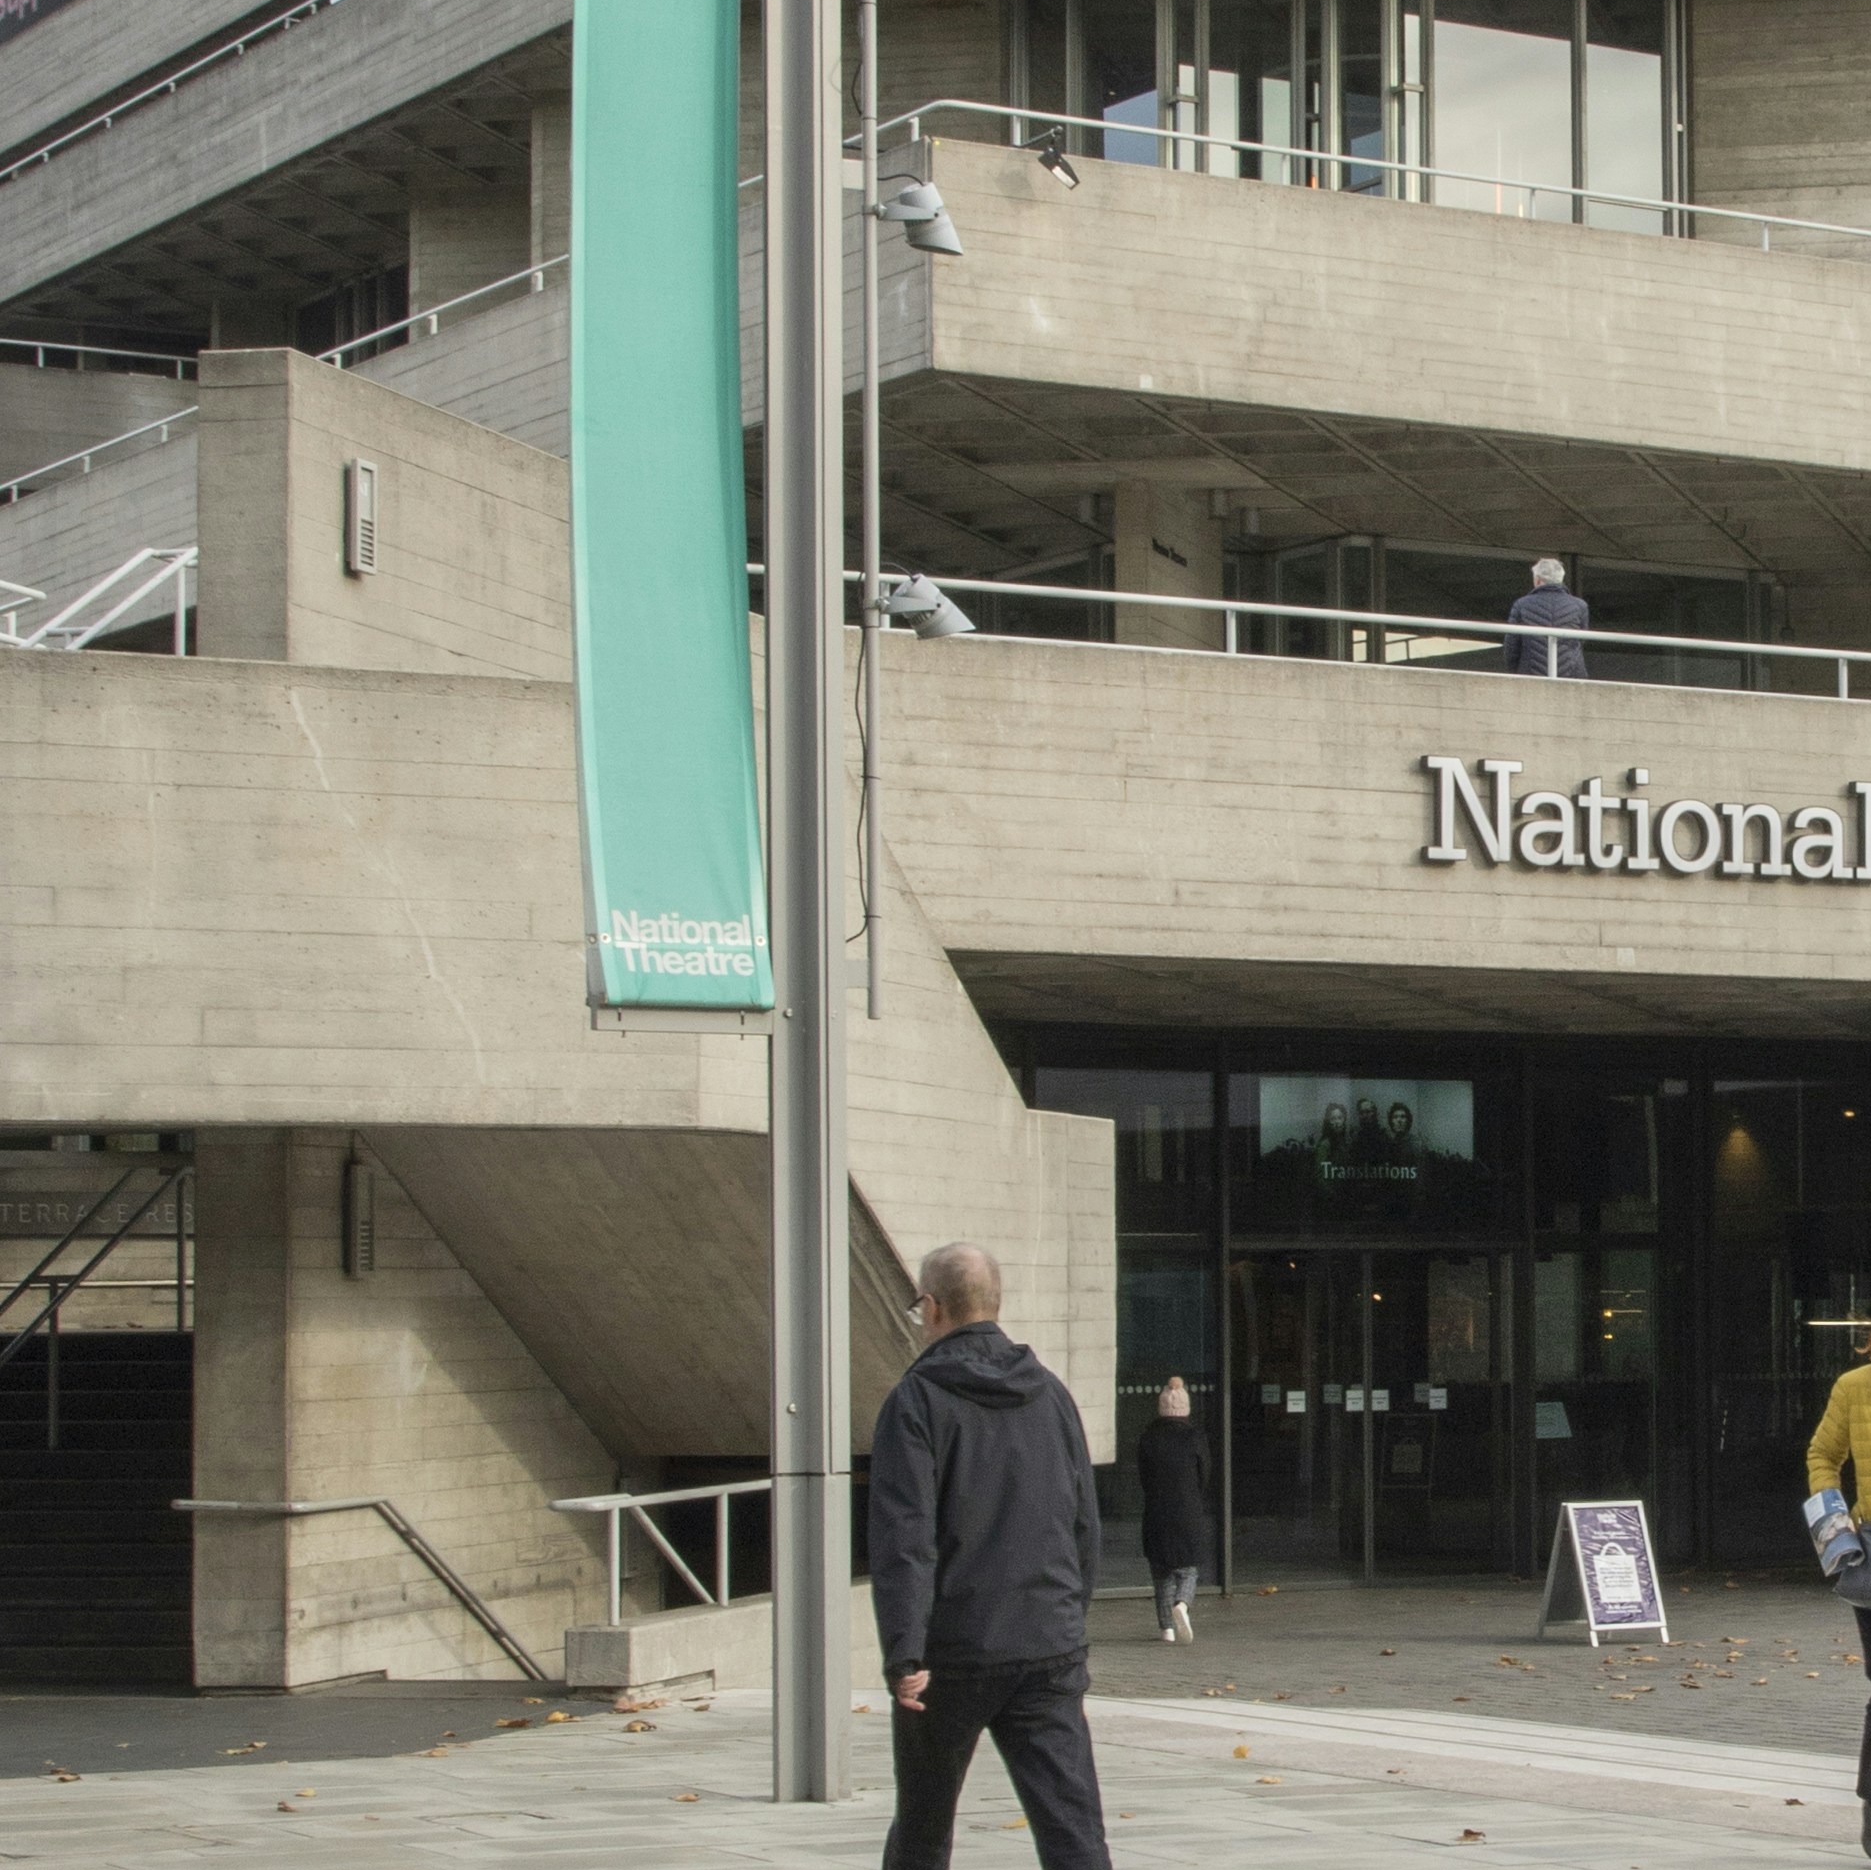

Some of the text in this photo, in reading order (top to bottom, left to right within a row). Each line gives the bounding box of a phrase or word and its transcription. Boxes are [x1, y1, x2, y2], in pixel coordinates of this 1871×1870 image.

[611, 909, 751, 947] National
[615, 940, 755, 977] Theatre
[1320, 1160, 1418, 1180] Translations
